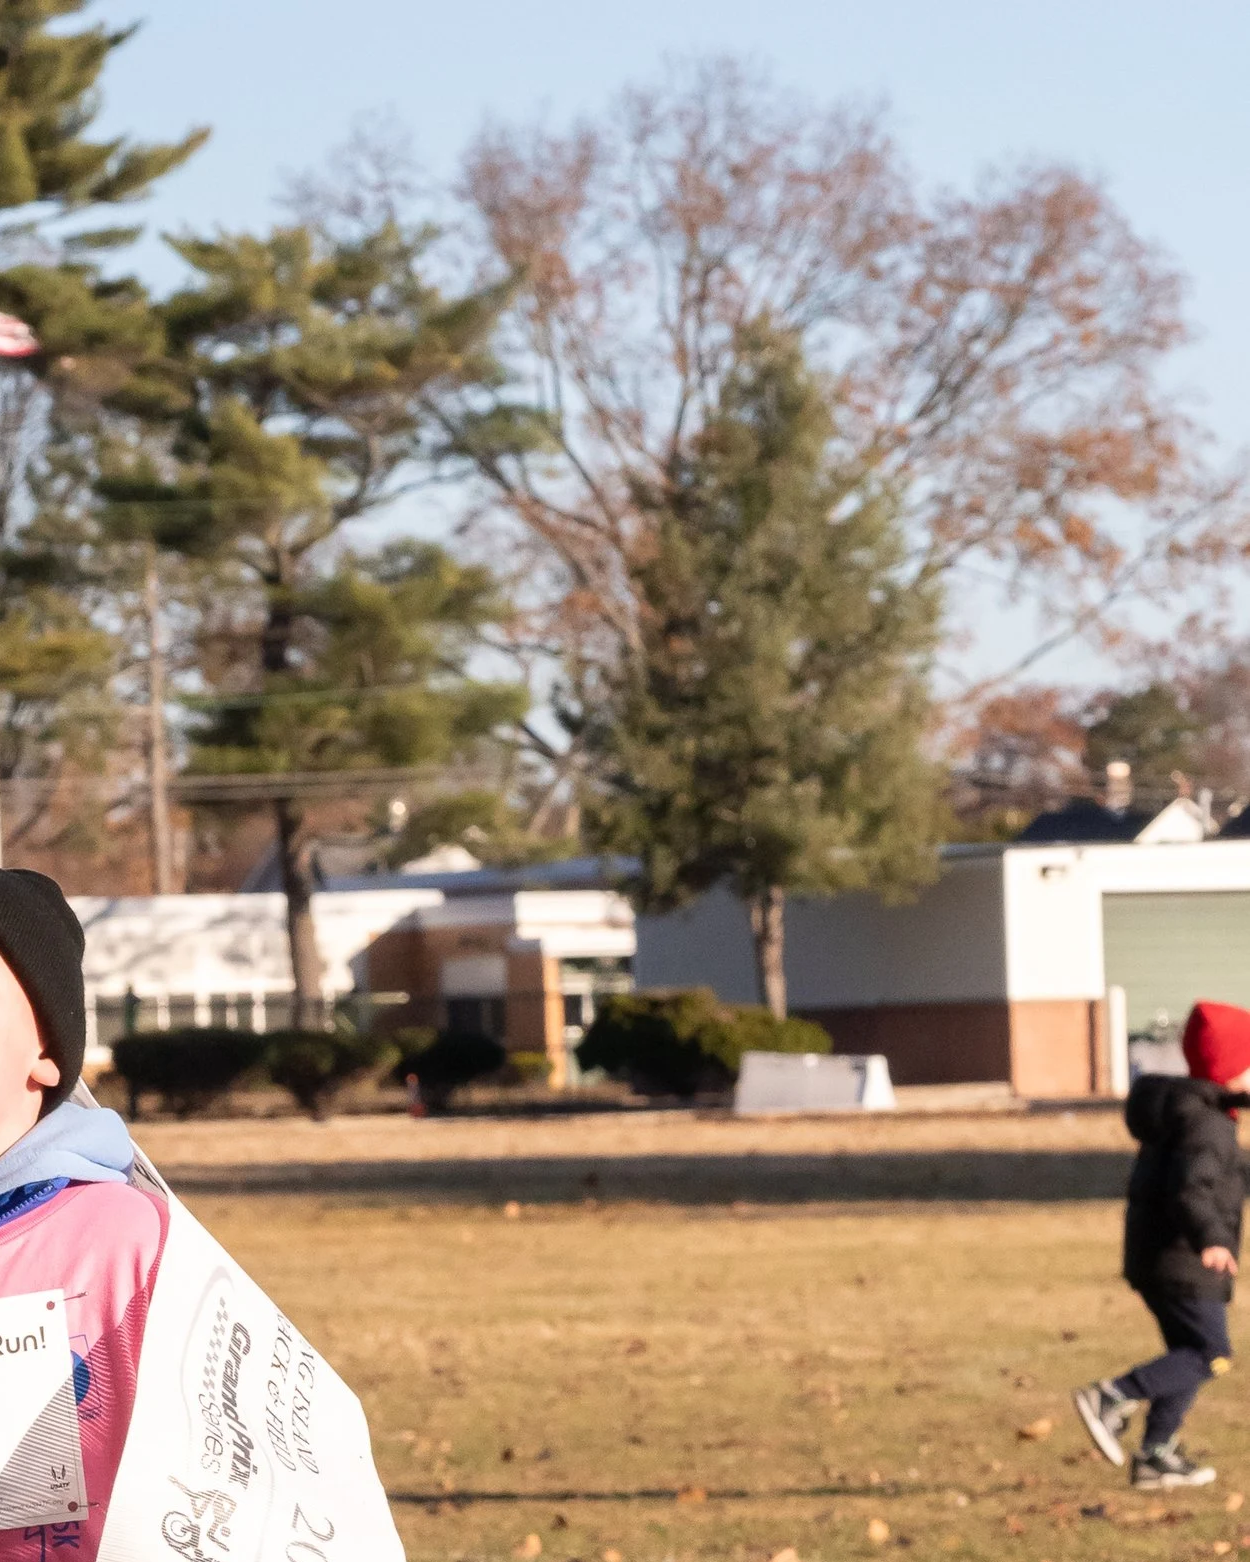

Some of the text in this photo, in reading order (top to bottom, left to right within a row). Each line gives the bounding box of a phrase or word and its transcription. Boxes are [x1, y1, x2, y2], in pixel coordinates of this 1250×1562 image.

[267, 1379, 286, 1408] &
[264, 1404, 297, 1472] FIELD
[290, 1384, 320, 1475] ISLAND
